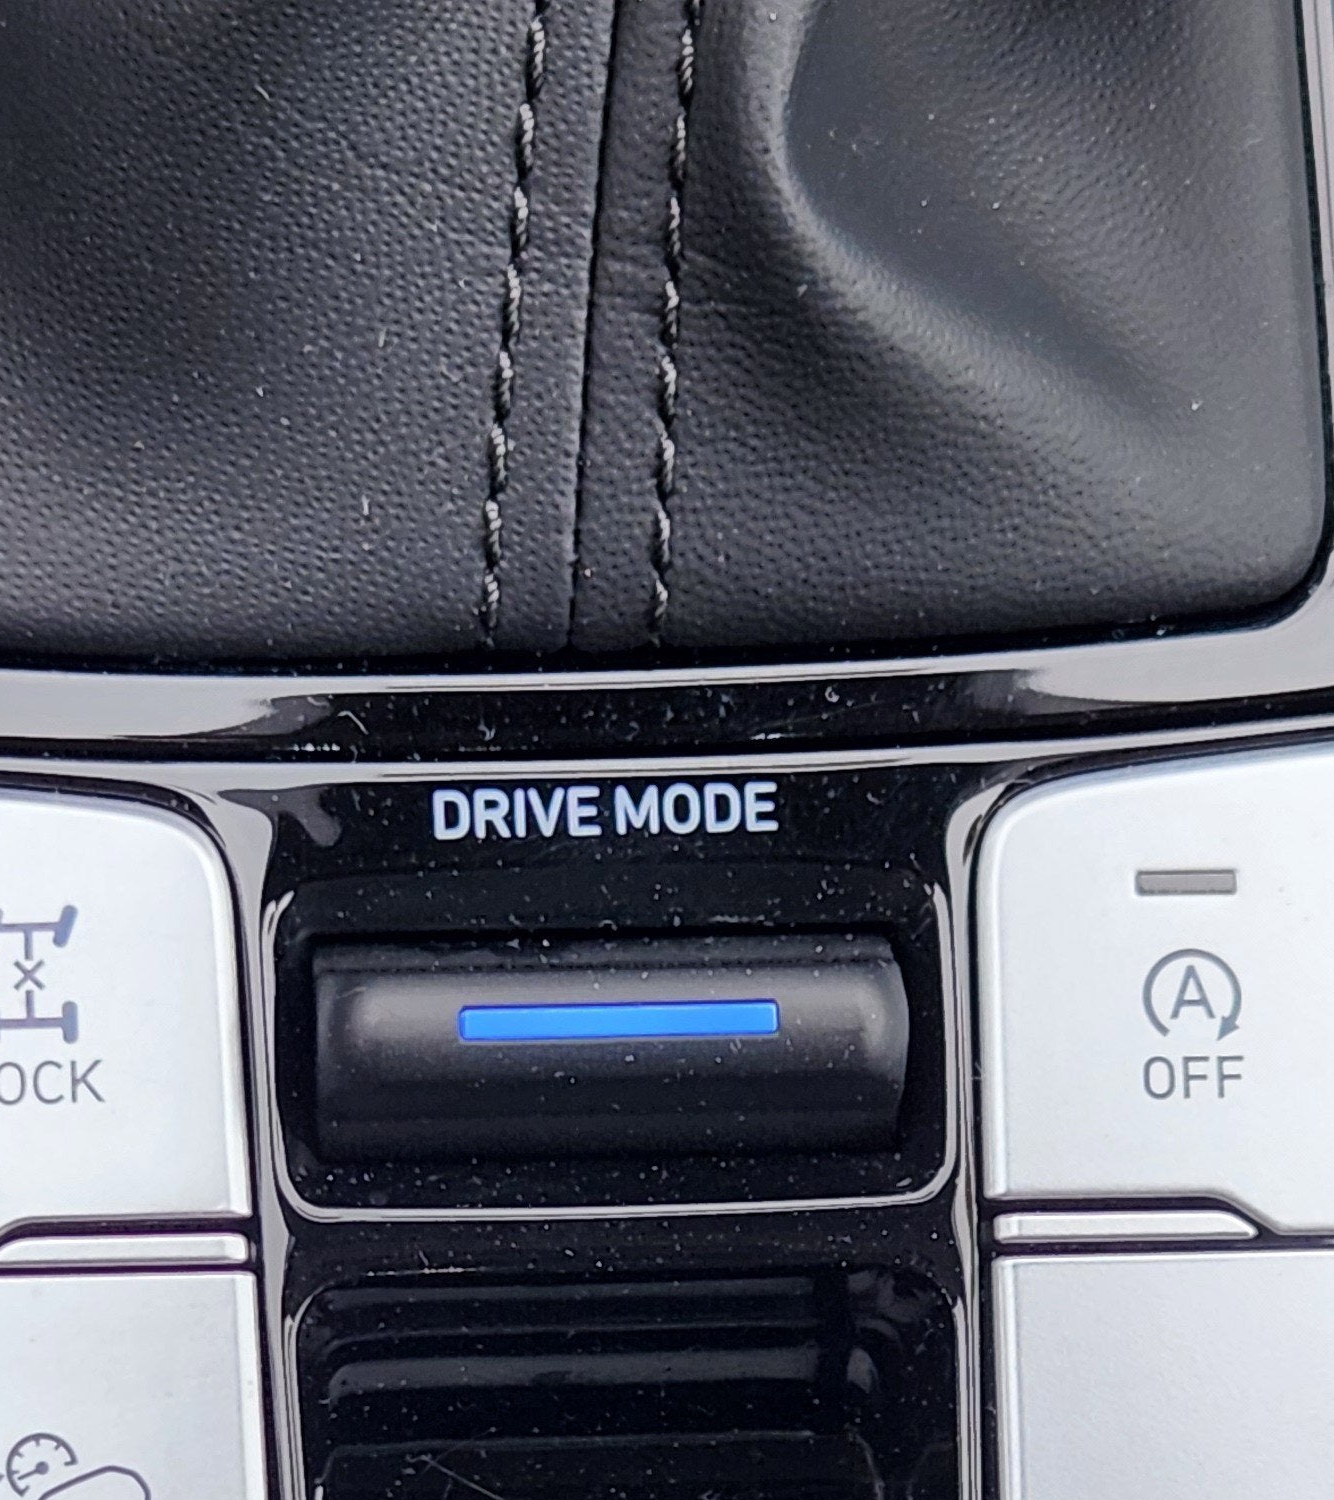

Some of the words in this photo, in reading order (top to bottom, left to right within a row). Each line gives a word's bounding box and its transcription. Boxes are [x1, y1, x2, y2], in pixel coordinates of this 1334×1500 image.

[431, 785, 602, 841] DRIVE
[614, 781, 779, 836] MODE
[1143, 1055, 1244, 1101] OFF
